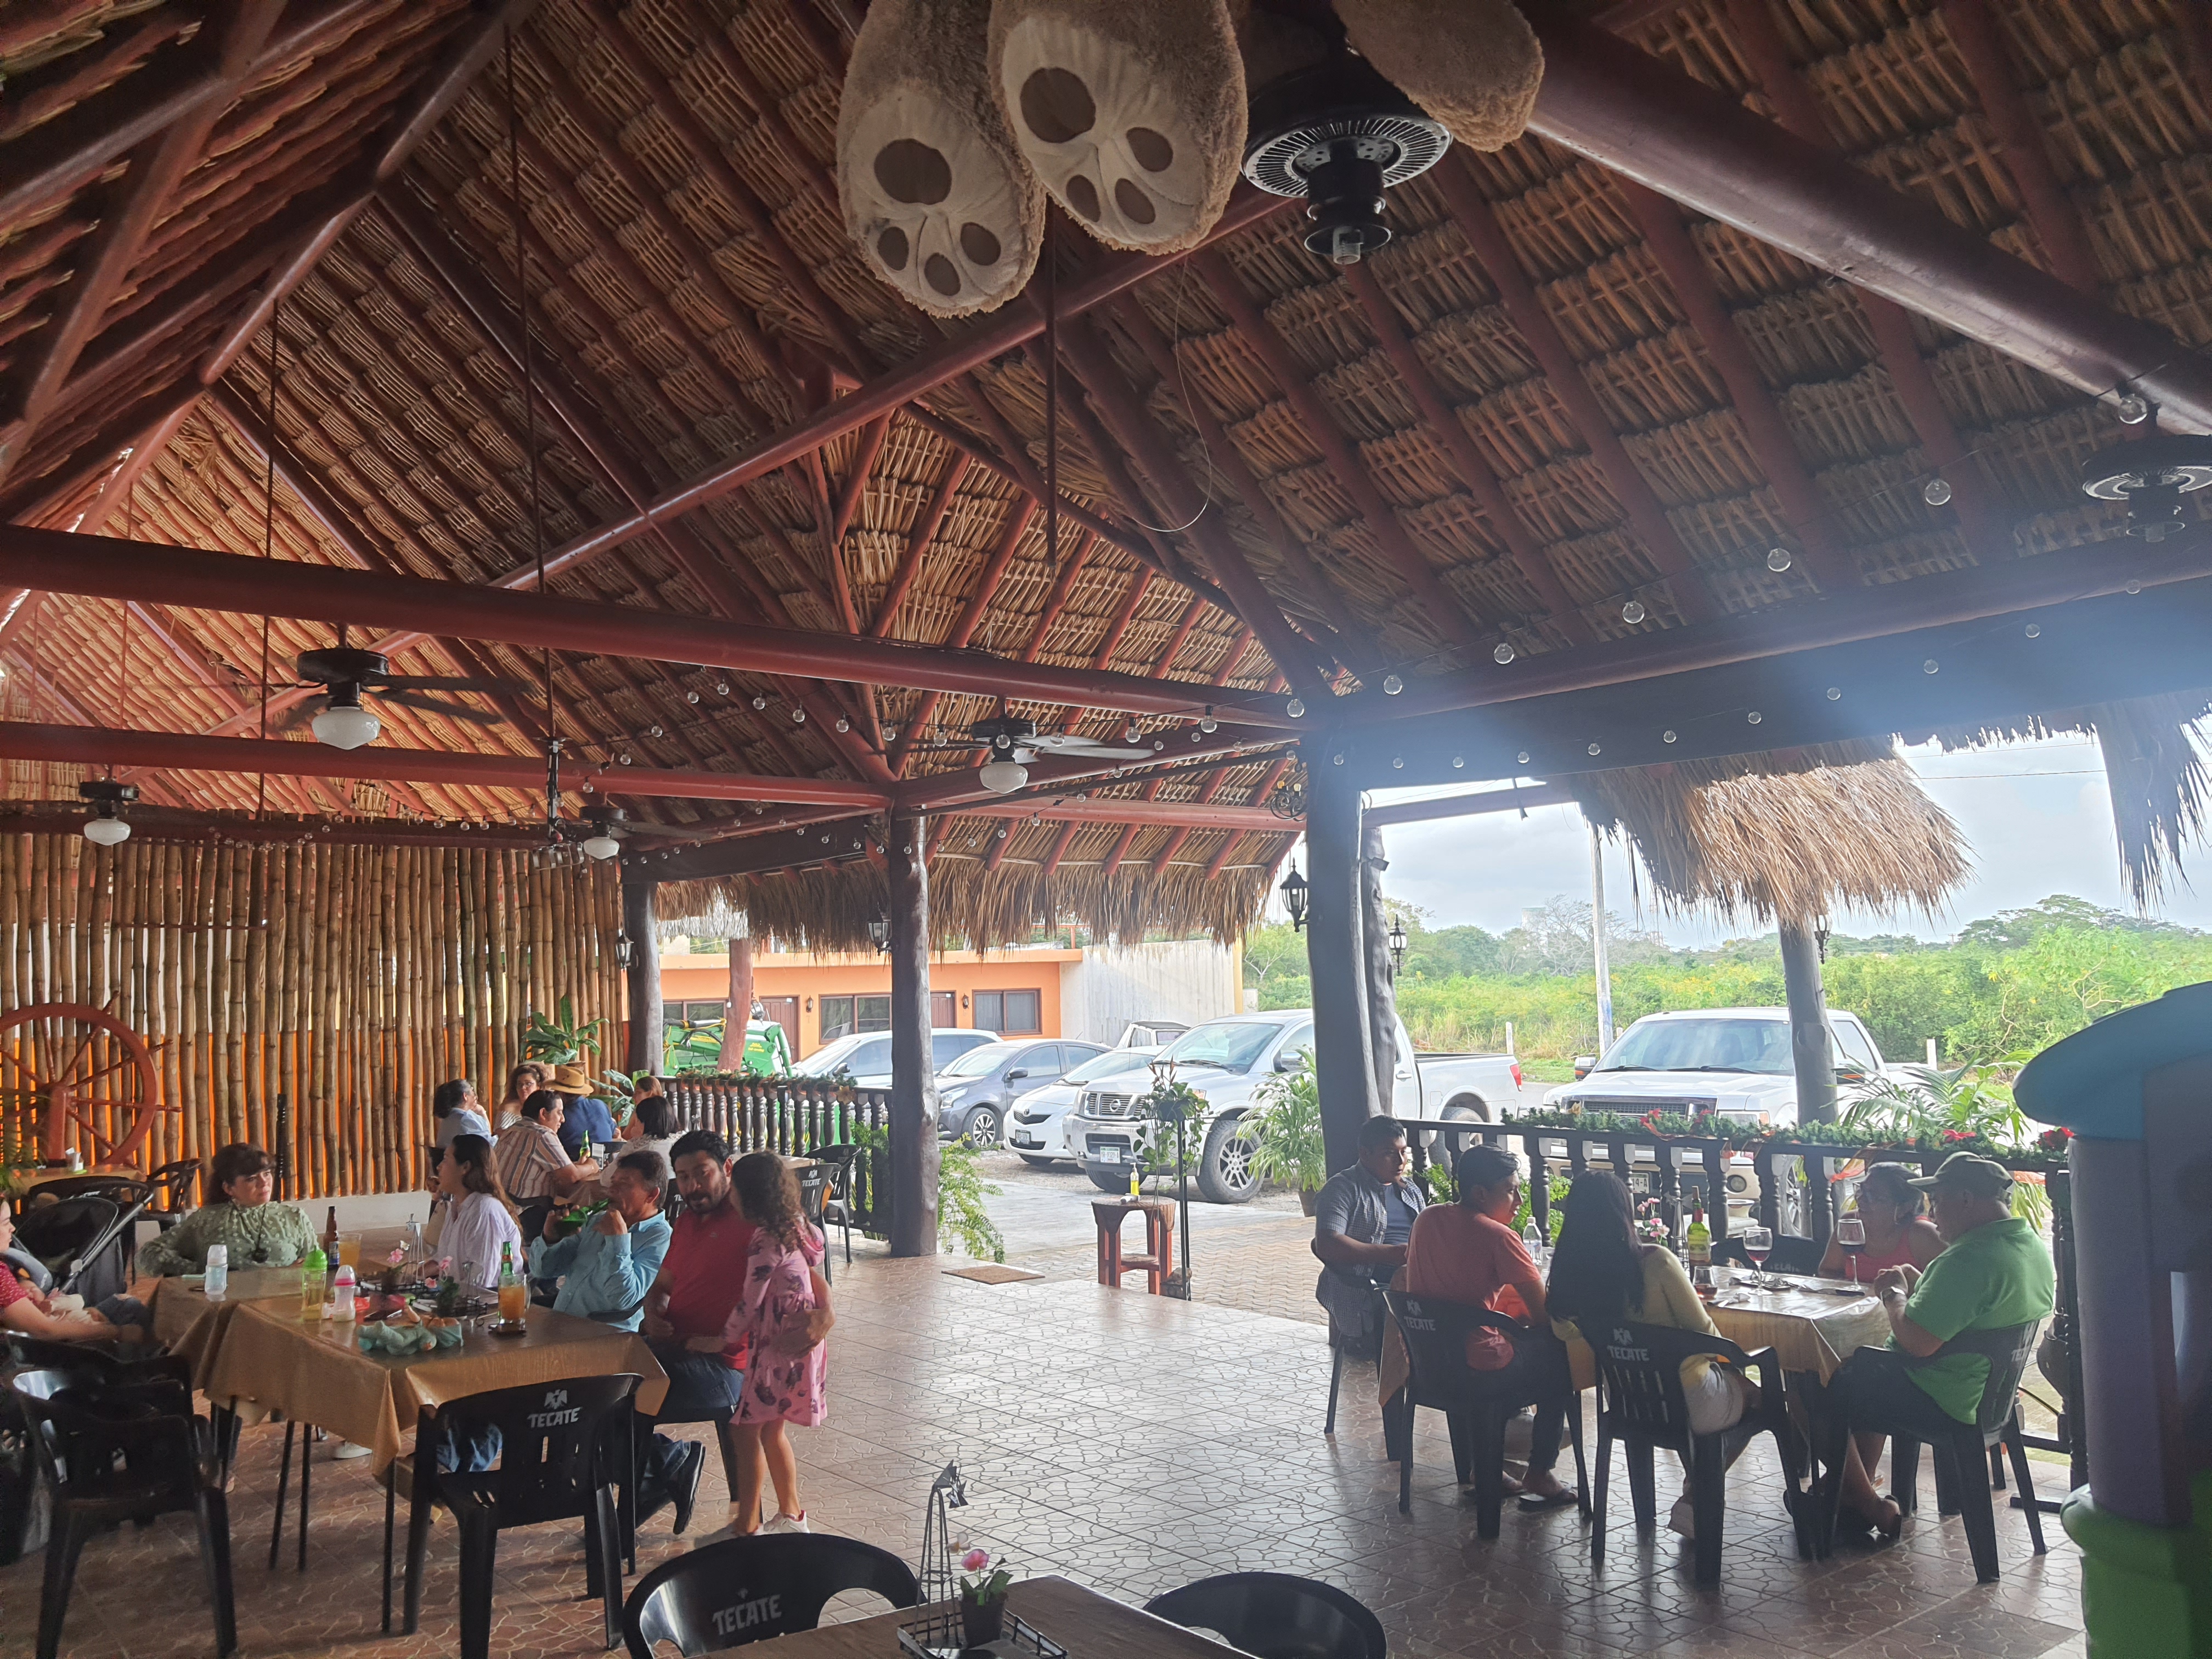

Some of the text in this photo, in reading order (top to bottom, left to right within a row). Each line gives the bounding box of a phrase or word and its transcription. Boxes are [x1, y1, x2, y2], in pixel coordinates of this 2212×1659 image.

[802, 1178, 821, 1187] TECATE
[1404, 1316, 1436, 1331] TECATE
[1606, 1345, 1650, 1361] TECATE
[527, 1407, 583, 1428] TECATE
[712, 1594, 782, 1635] TECATE
